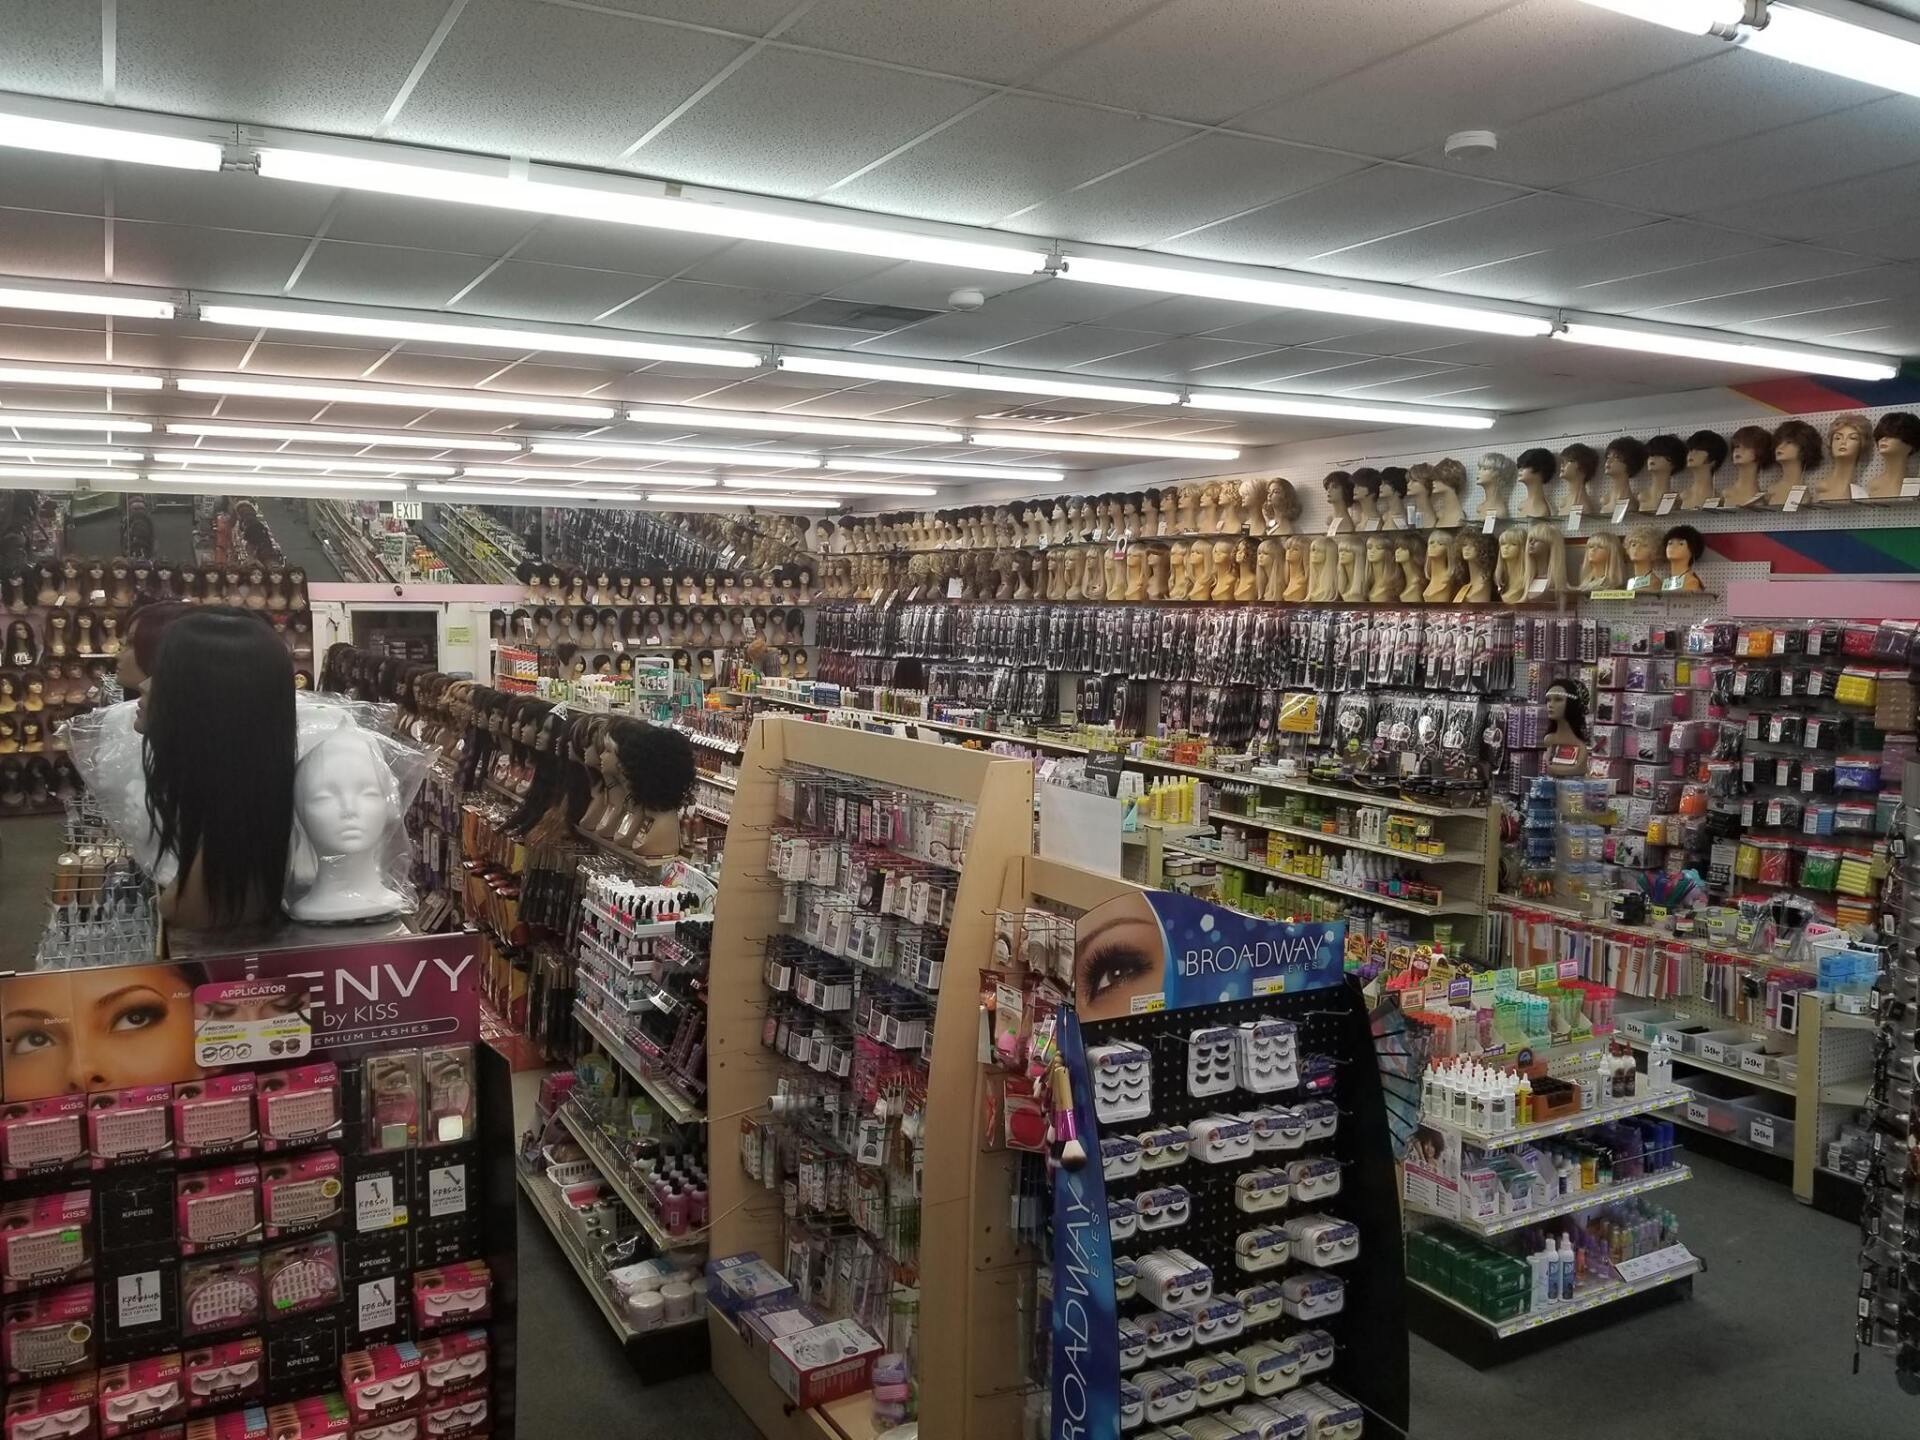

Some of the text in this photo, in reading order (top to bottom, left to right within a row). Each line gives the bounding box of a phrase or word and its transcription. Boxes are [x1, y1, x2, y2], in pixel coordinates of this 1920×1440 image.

[396, 503, 420, 518] EXIT
[1185, 935, 1324, 977] BROADWAY
[1288, 961, 1318, 973] EYES
[220, 984, 286, 999] APPLICATOR
[323, 1002, 399, 1030] by KISS
[314, 1024, 429, 1046] EMIUM LASHES
[315, 1075, 335, 1084] KISS
[232, 1083, 254, 1092] KISS
[146, 1093, 169, 1102] KISS
[60, 1102, 85, 1111] KISS
[315, 1163, 336, 1172] KISS
[234, 1177, 257, 1186] KISS
[63, 1209, 87, 1220] KISS
[1090, 1211, 1100, 1278] EYES
[64, 1305, 88, 1314] KISS
[1062, 1182, 1091, 1440] ROADWAY
[239, 1347, 262, 1356] KISS
[399, 1359, 421, 1369] KISS
[157, 1367, 181, 1377] KISS
[68, 1392, 94, 1402] KISS
[327, 1419, 349, 1428] KISS
